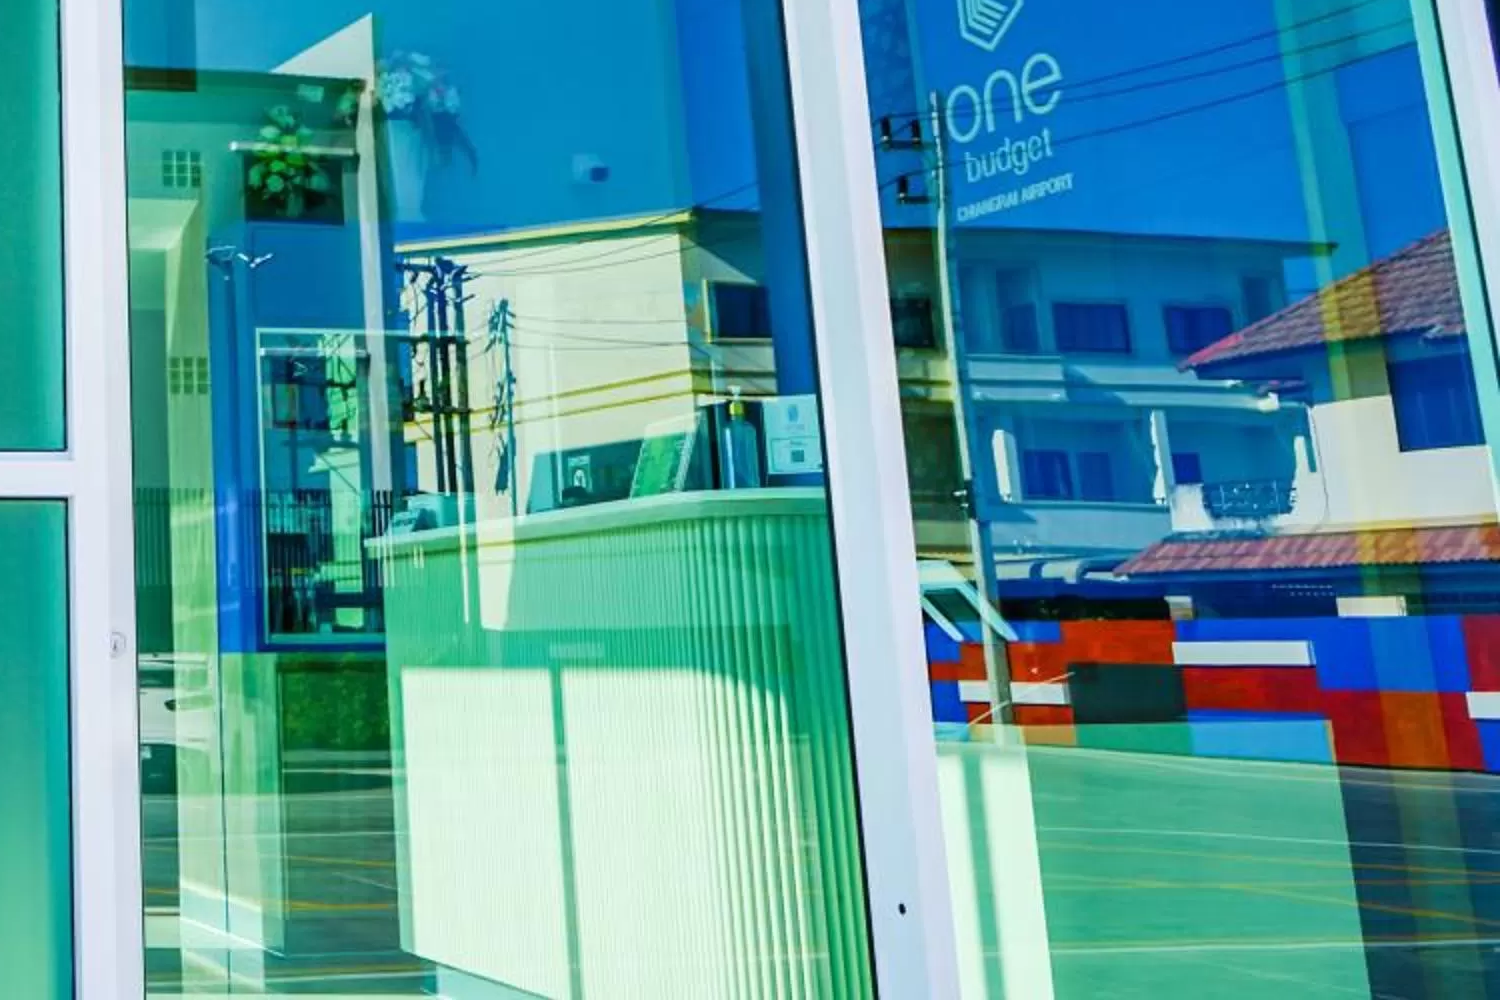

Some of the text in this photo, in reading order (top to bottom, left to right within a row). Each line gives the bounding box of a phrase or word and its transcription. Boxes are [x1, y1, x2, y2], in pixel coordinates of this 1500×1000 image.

[946, 53, 1064, 143] one
[964, 127, 1053, 183] budget
[1021, 173, 1074, 204] AIRPORT
